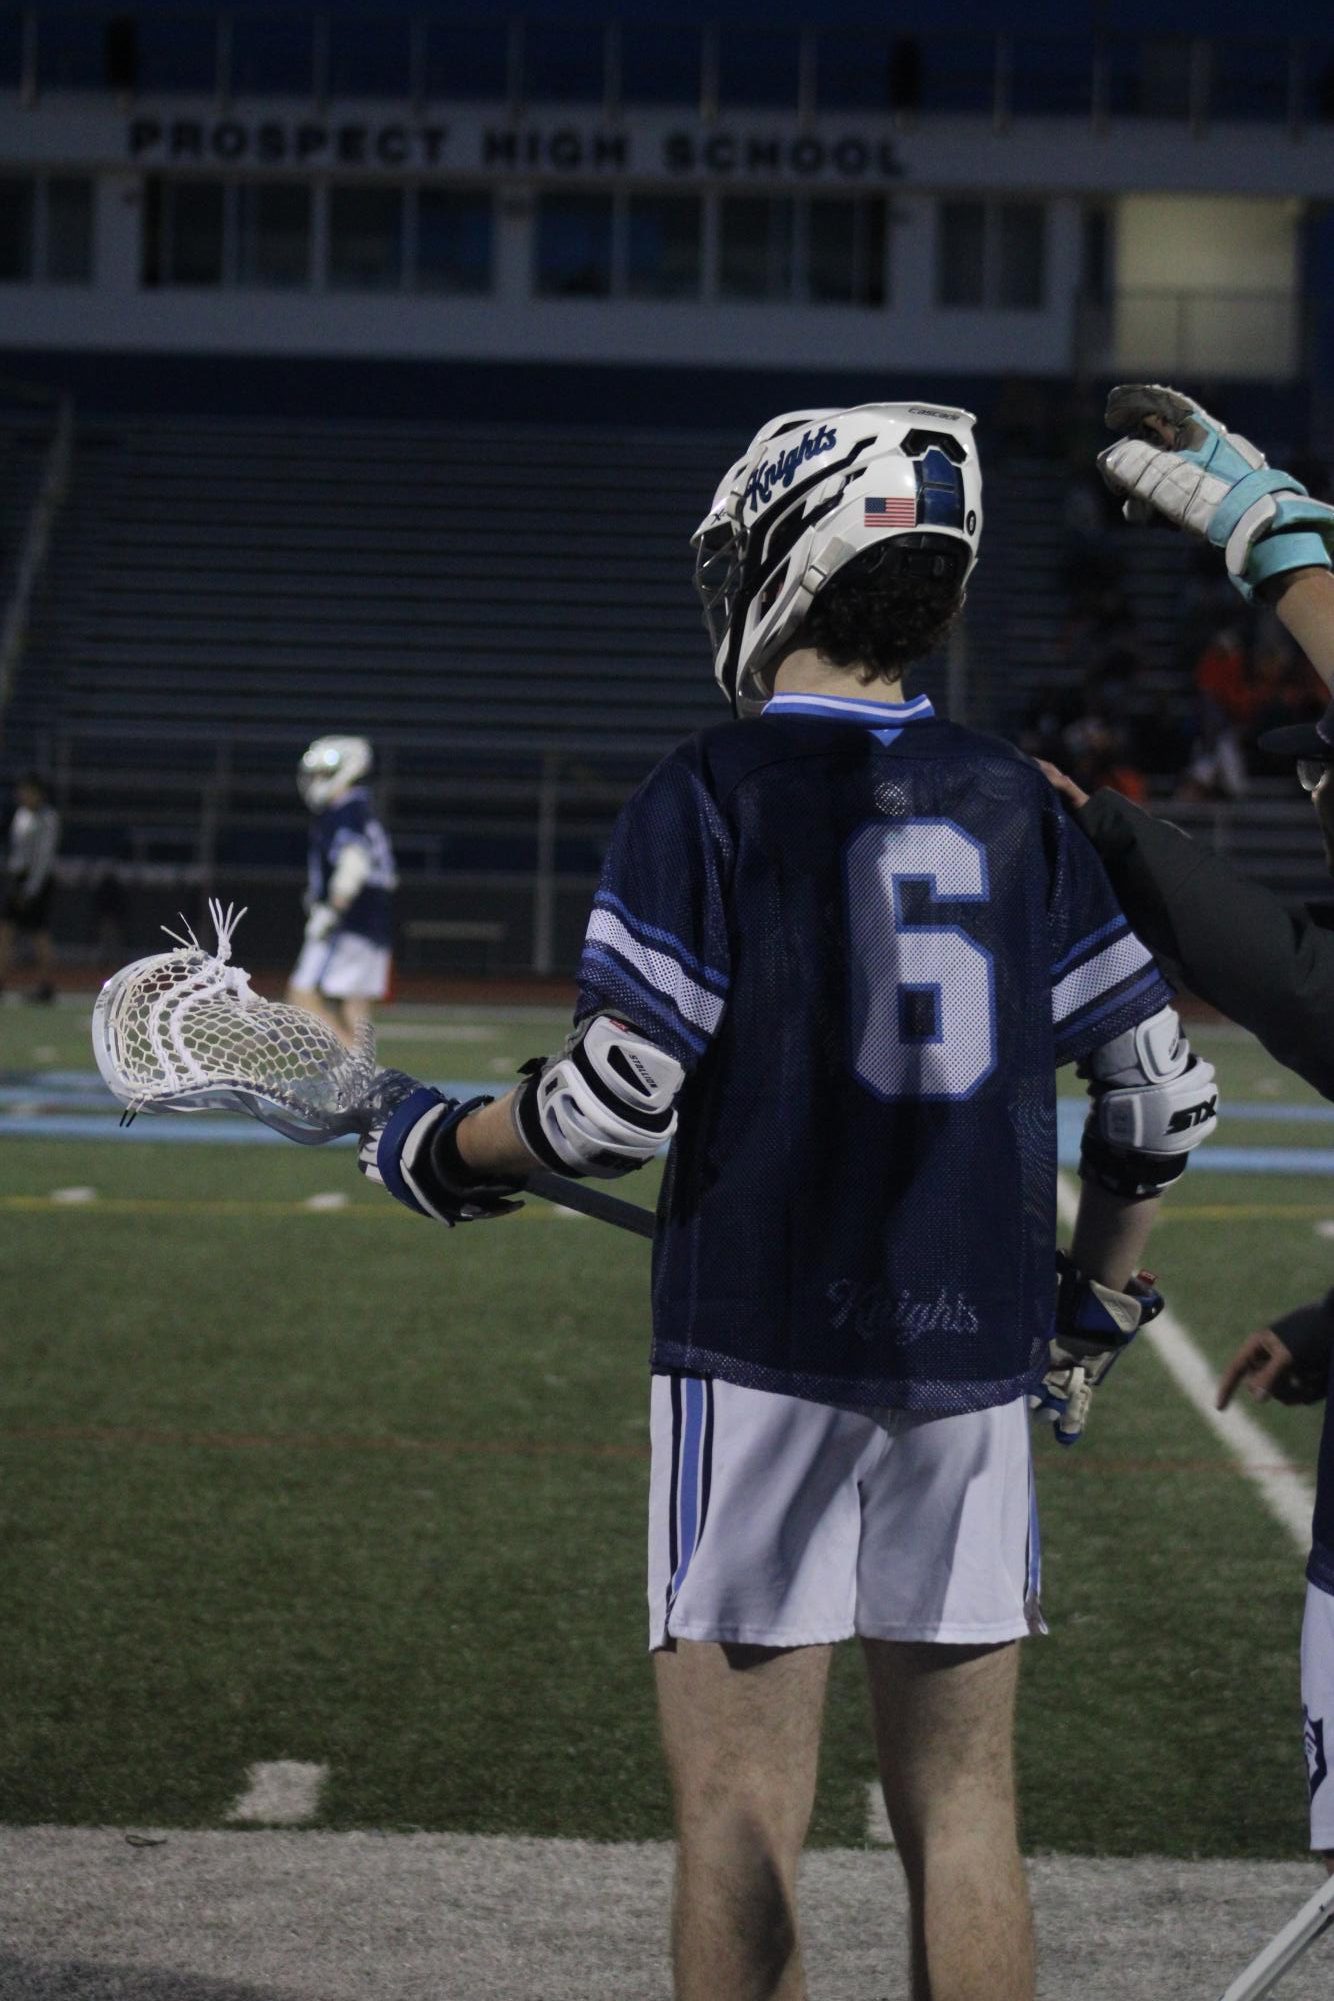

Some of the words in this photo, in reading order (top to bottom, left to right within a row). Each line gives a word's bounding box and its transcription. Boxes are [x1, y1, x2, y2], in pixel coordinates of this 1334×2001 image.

[129, 120, 448, 163] PROSPECT
[483, 129, 627, 169] HIGH
[664, 130, 904, 177] SCHOOL
[744, 424, 837, 513] Knights
[840, 816, 998, 1103] 6
[1164, 1094, 1218, 1136] STX
[826, 1277, 979, 1346] Knights
